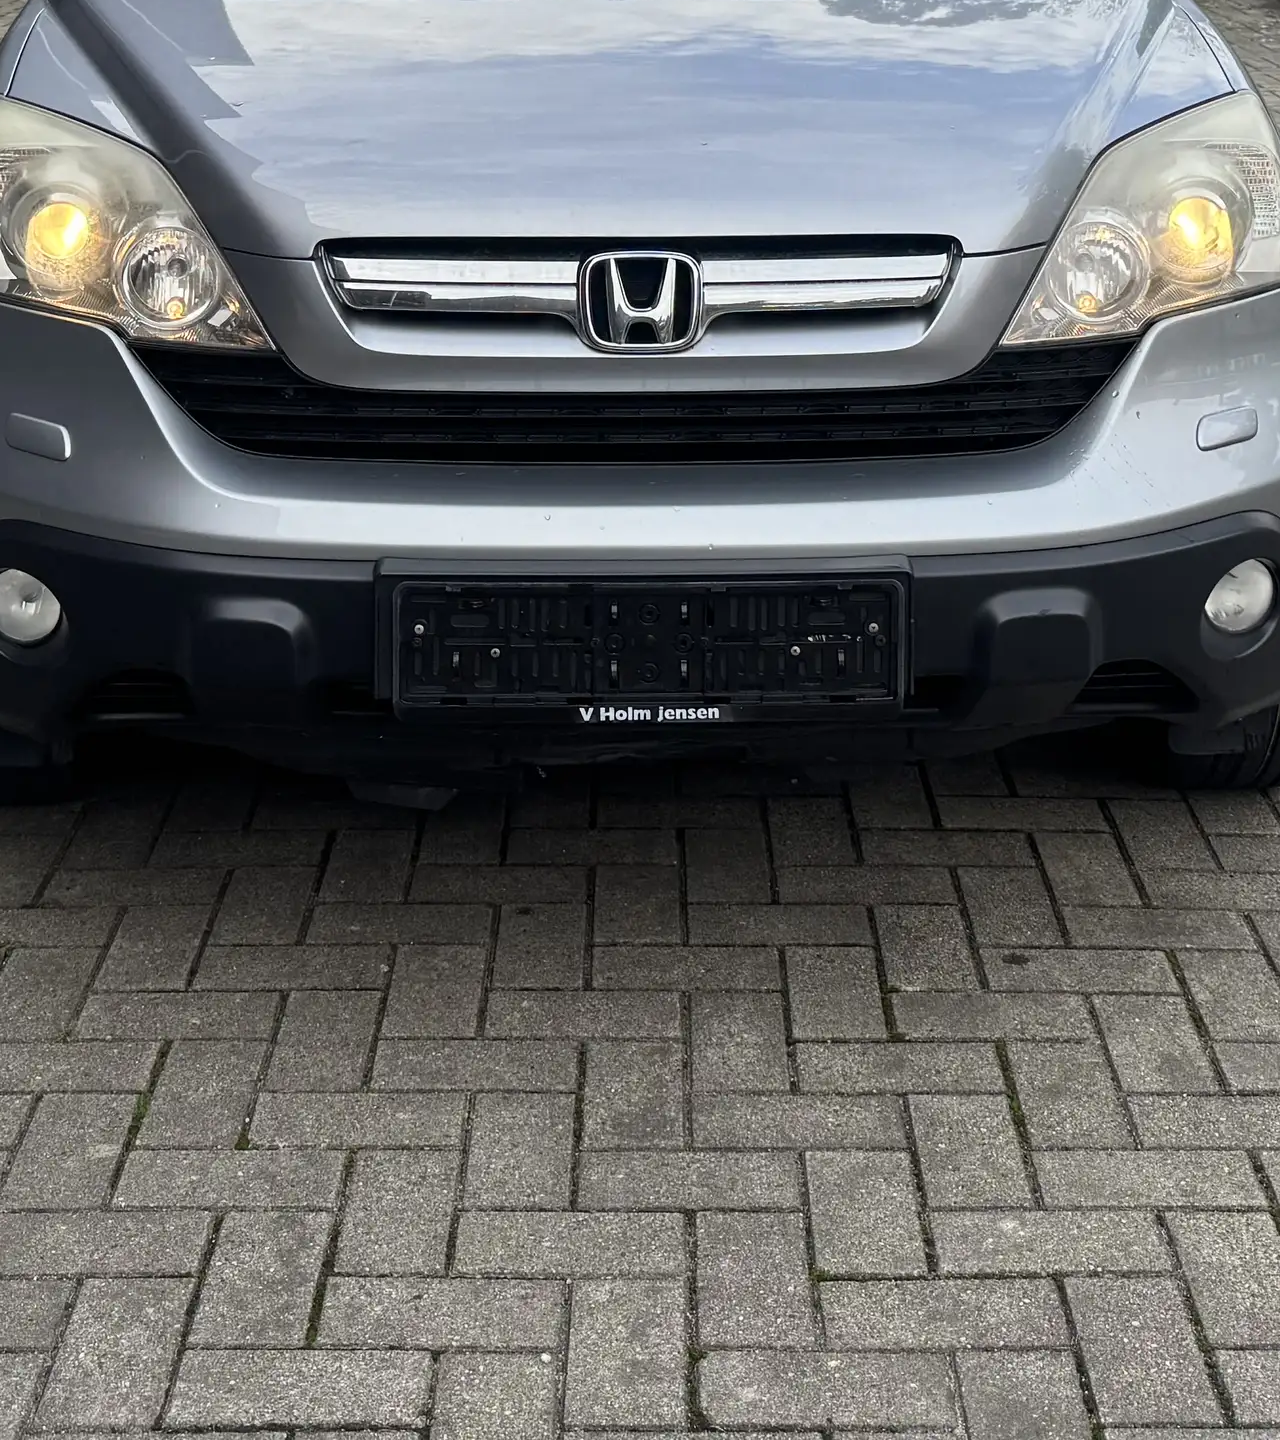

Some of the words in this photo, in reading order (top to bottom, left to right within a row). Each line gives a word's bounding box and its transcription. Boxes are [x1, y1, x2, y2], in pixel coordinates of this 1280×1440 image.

[579, 707, 594, 721] V
[599, 707, 652, 721] Holm
[657, 706, 720, 722] jensen
